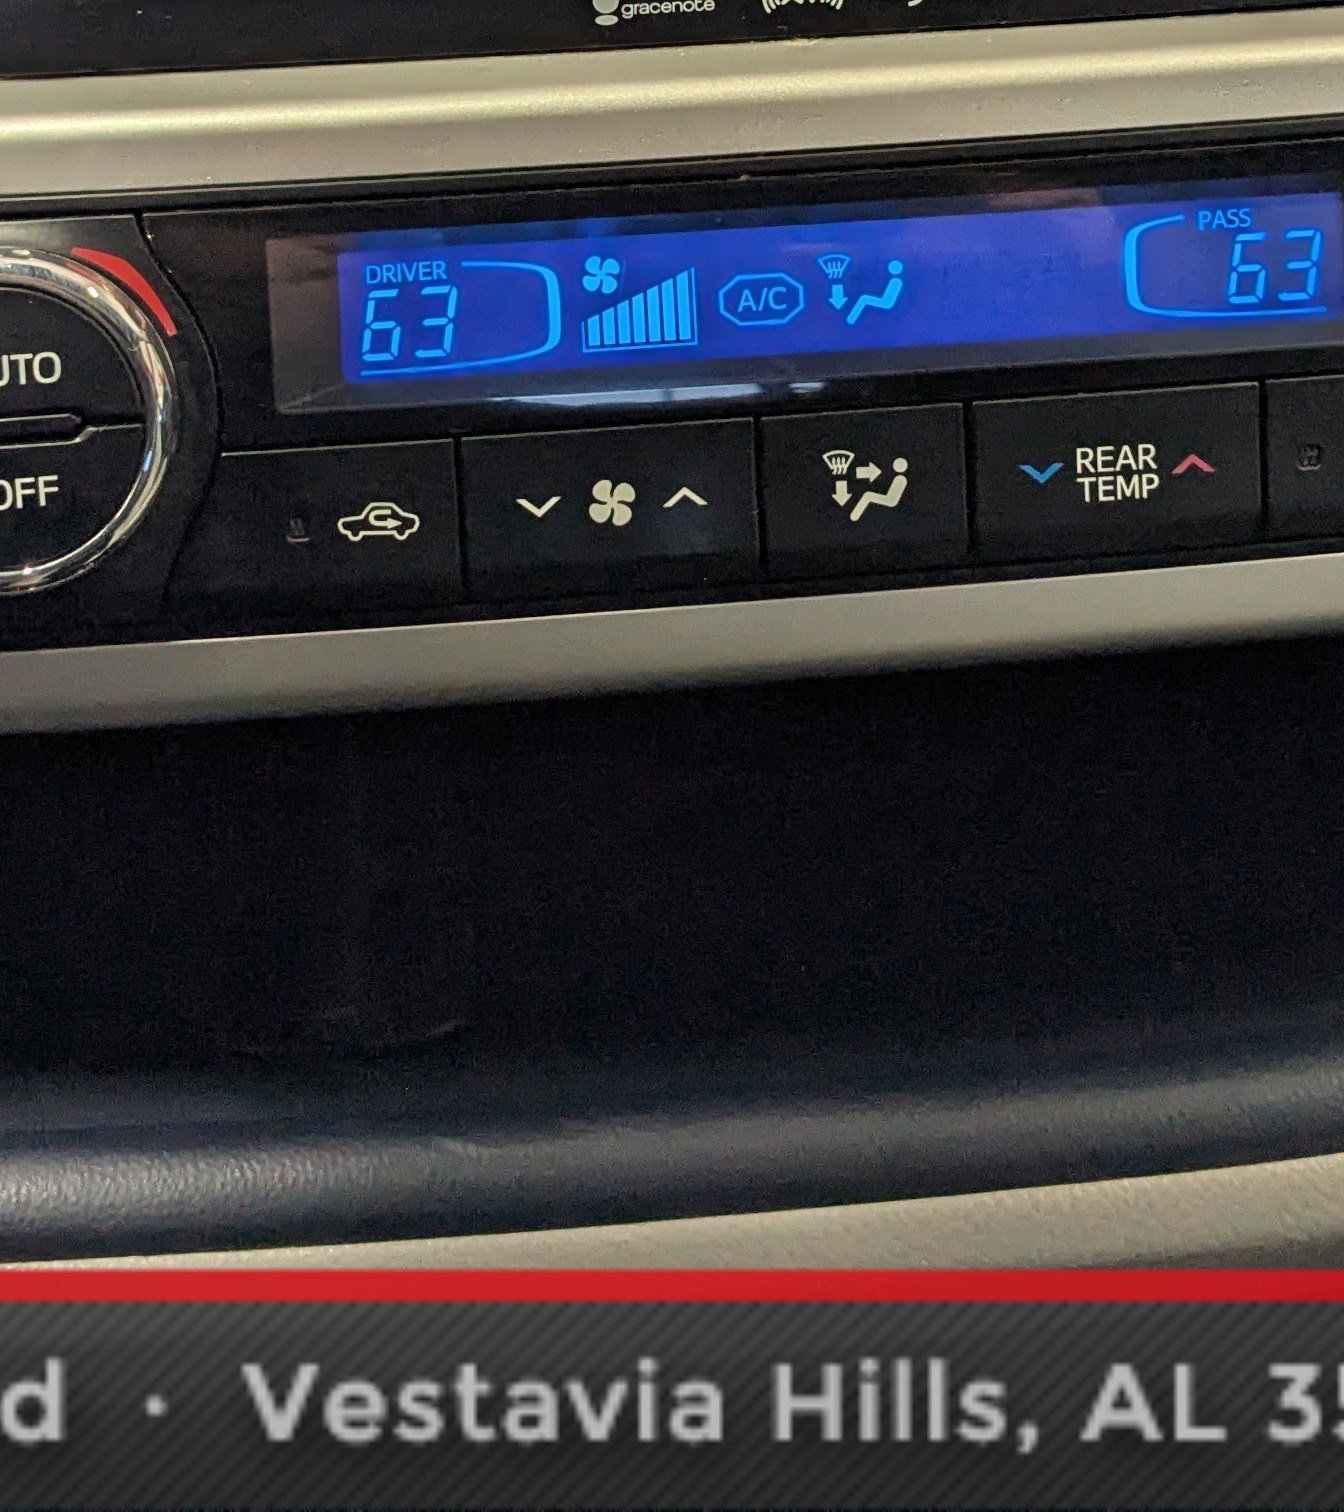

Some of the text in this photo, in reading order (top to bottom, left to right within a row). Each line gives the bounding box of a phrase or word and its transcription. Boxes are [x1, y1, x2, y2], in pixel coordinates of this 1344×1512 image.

[1197, 207, 1252, 231] PASS
[365, 260, 448, 286] DRIVER
[1227, 229, 1322, 305] 63
[737, 285, 789, 313] A/C
[360, 284, 458, 362] 63
[1075, 443, 1159, 475] REAR
[1076, 472, 1160, 503] TEMP
